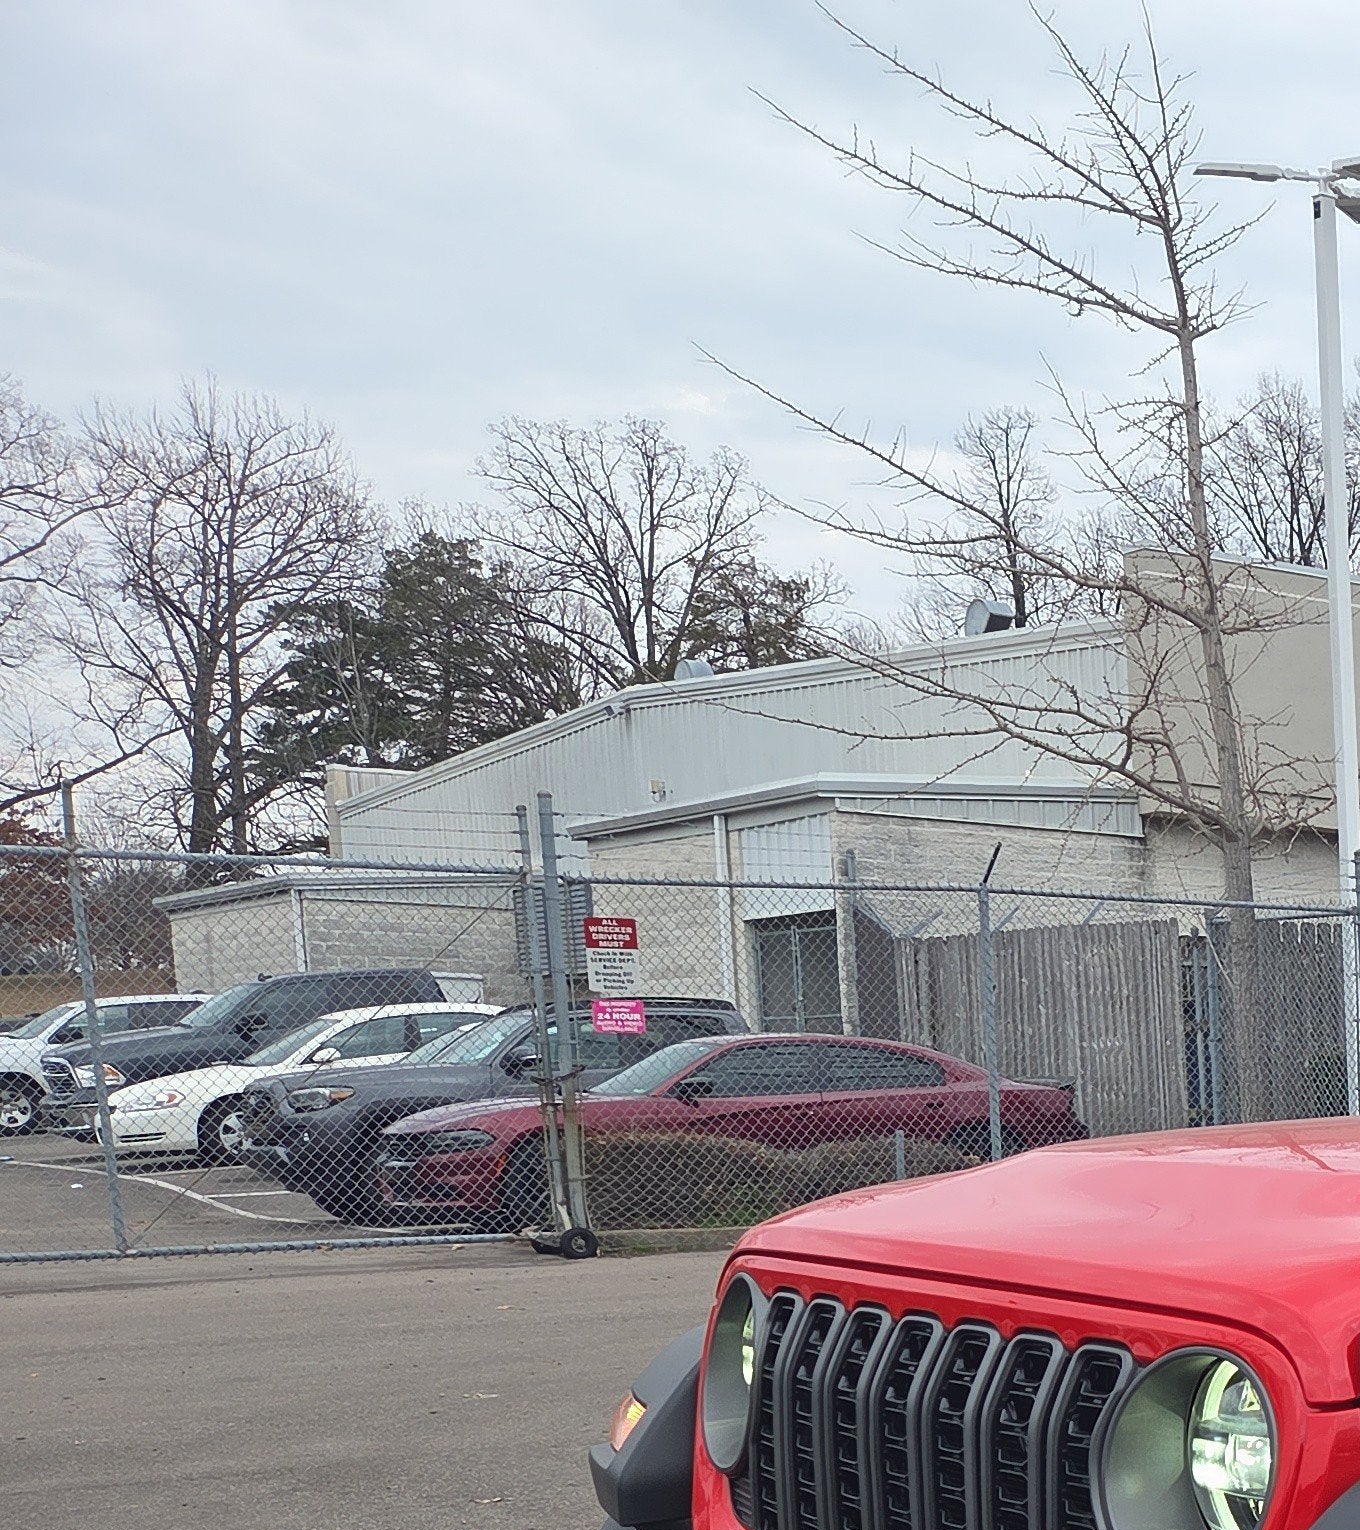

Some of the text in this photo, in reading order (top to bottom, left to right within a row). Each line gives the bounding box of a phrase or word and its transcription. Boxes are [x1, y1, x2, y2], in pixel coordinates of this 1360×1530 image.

[588, 926, 633, 934] WRECKER
[592, 933, 631, 941] DRIVERS
[597, 1012, 641, 1020] 24 HOUR
